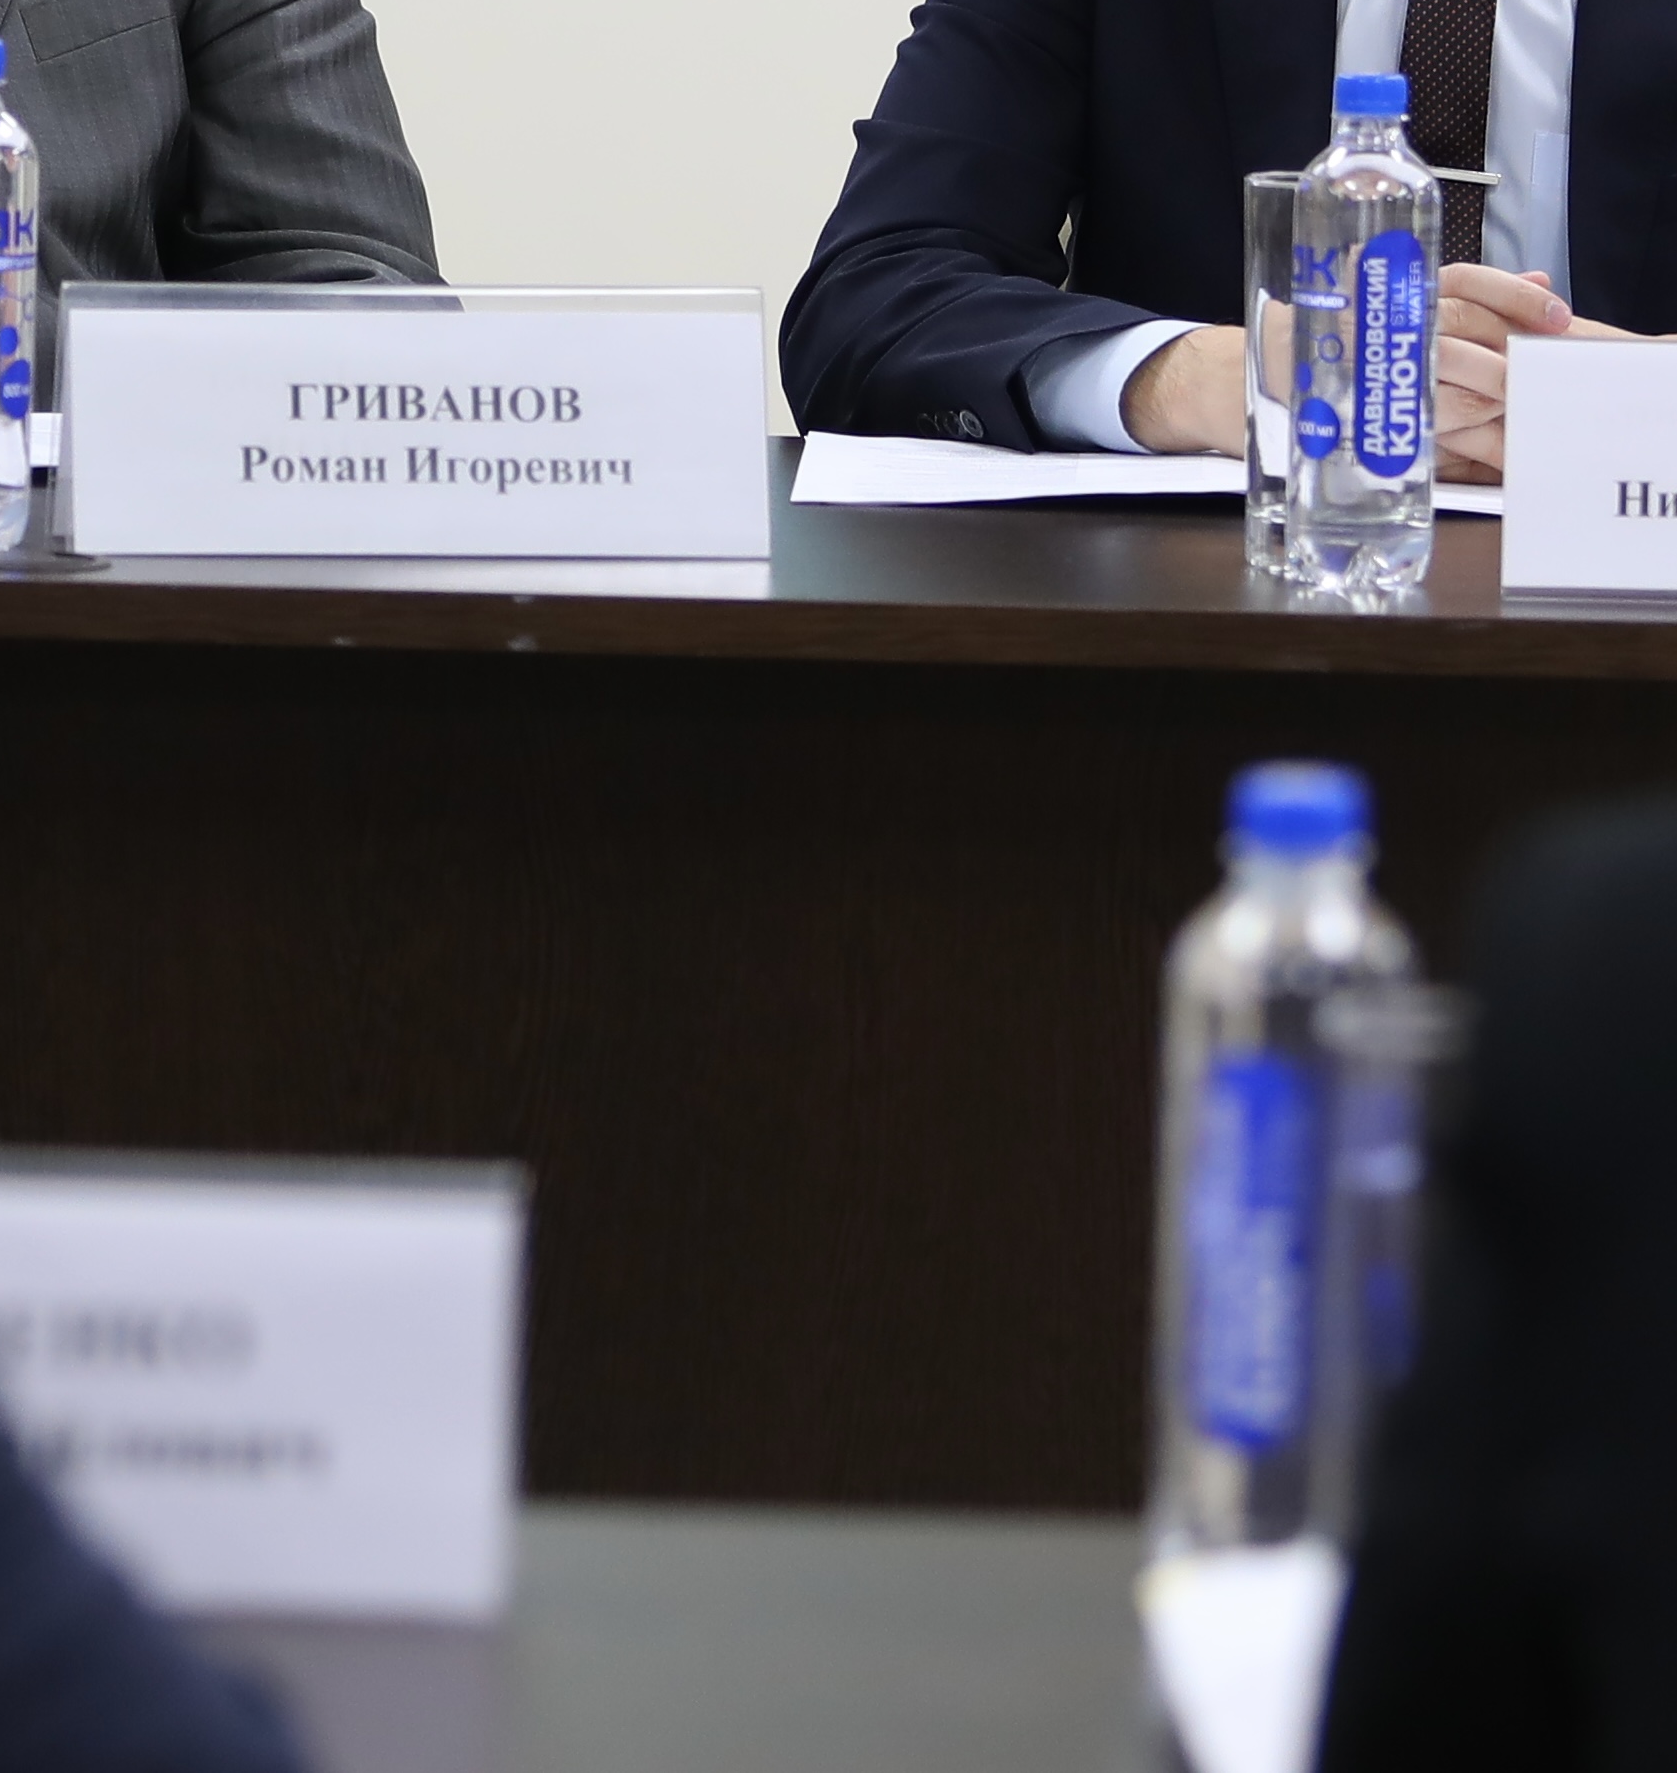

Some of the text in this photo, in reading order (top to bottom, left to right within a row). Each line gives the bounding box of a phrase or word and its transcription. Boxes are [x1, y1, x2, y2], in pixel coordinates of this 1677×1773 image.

[1390, 277, 1407, 326] STILL
[1409, 260, 1423, 326] WATER
[1363, 256, 1388, 457] ДАВЫДОВСКИЙ
[287, 383, 582, 423] ГРИВАНОВ
[1389, 331, 1419, 457] КЛЮЧ
[239, 444, 633, 495] Роман Игоревич
